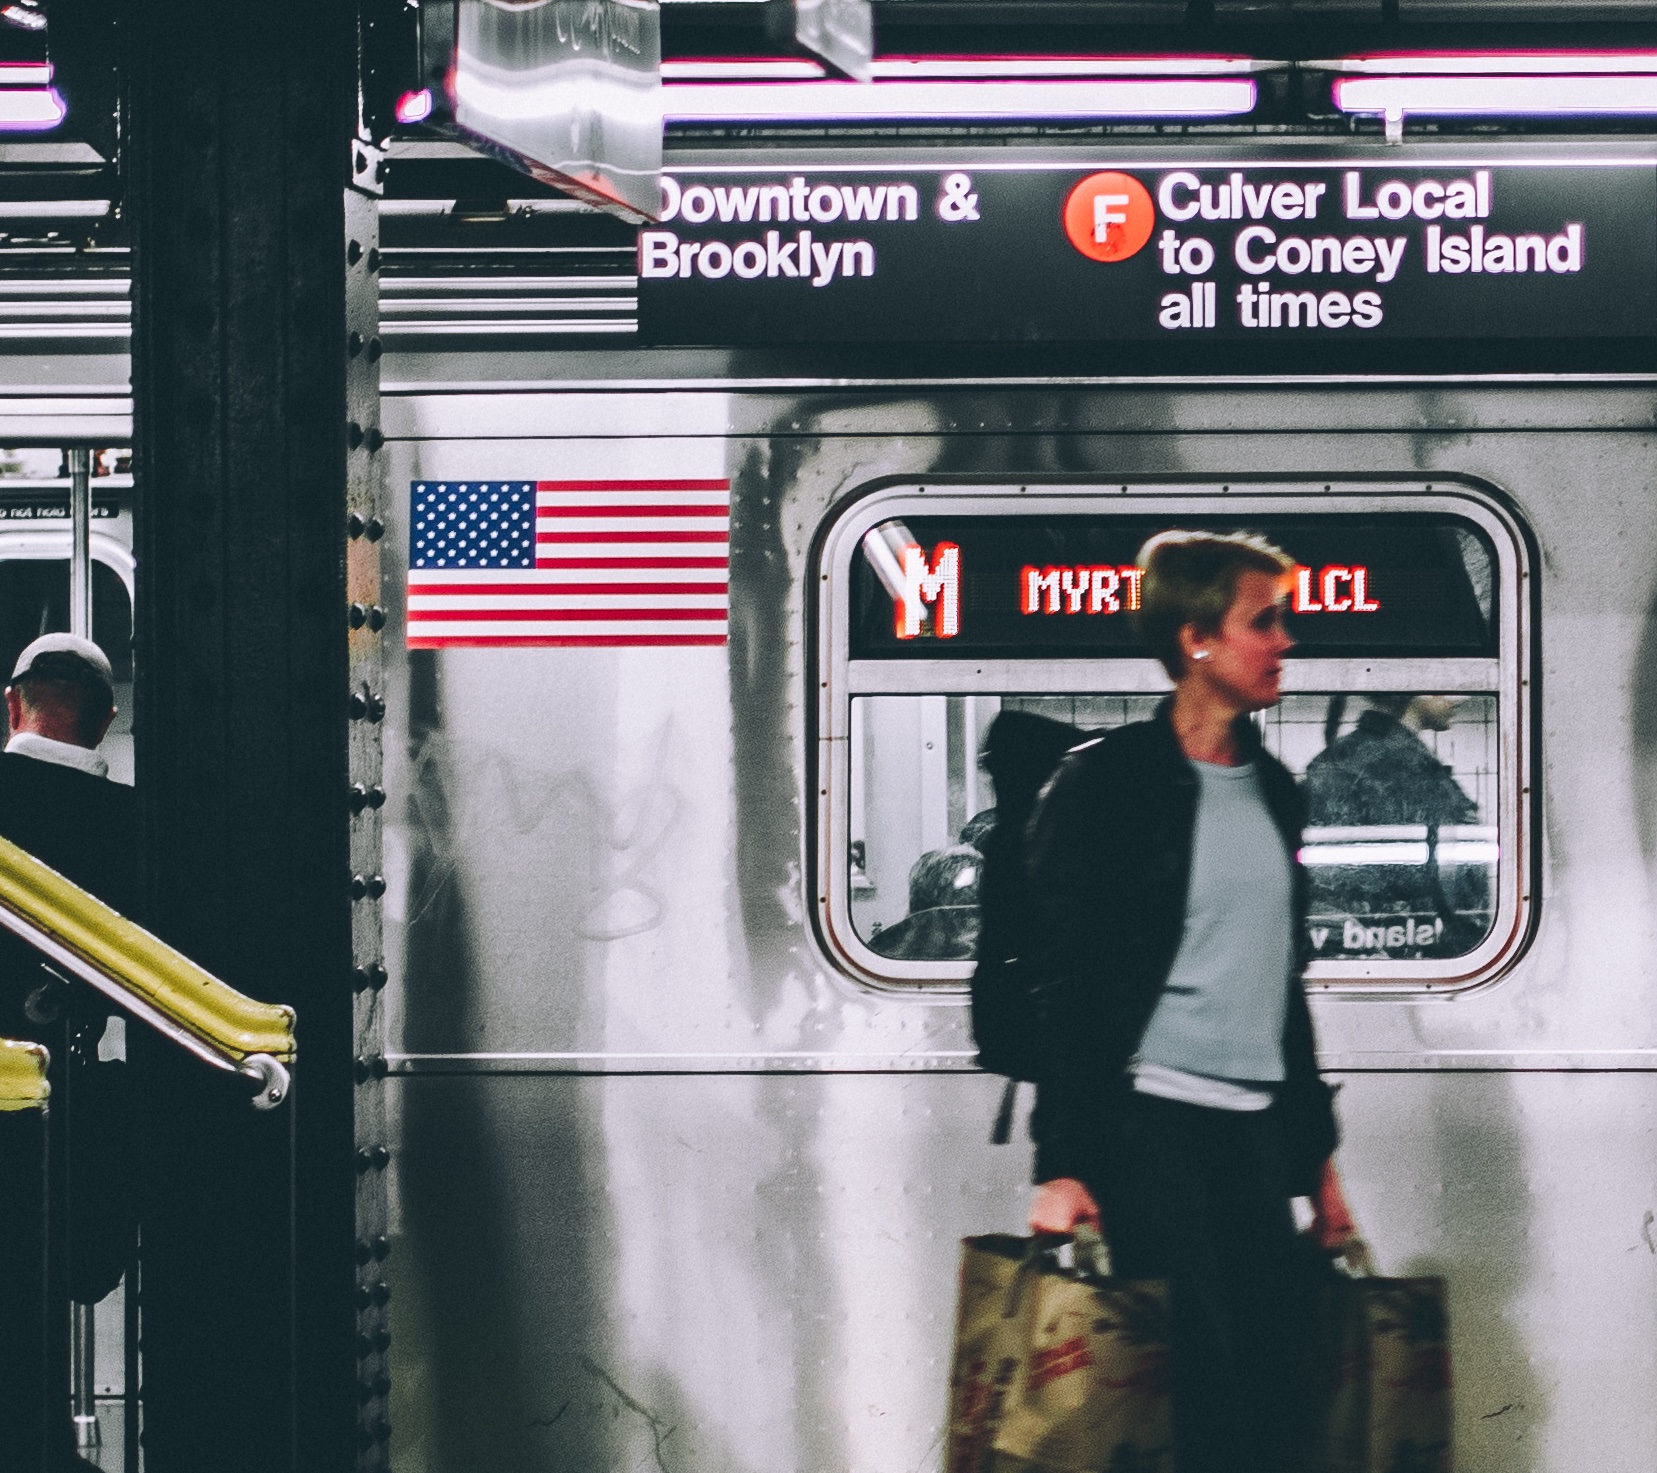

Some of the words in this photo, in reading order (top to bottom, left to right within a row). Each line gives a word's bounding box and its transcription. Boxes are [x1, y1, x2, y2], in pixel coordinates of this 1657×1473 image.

[938, 173, 981, 221] &
[1093, 194, 1129, 243] F
[1158, 172, 1326, 221] Culver
[1346, 171, 1490, 219] Local
[641, 230, 876, 287] Brooklyn
[1159, 230, 1214, 275] to
[1235, 226, 1407, 282] Coney
[1427, 224, 1582, 274] Island
[1159, 282, 1215, 329] all
[1237, 283, 1383, 329] times
[896, 542, 960, 639] M
[1293, 564, 1380, 613] LCL
